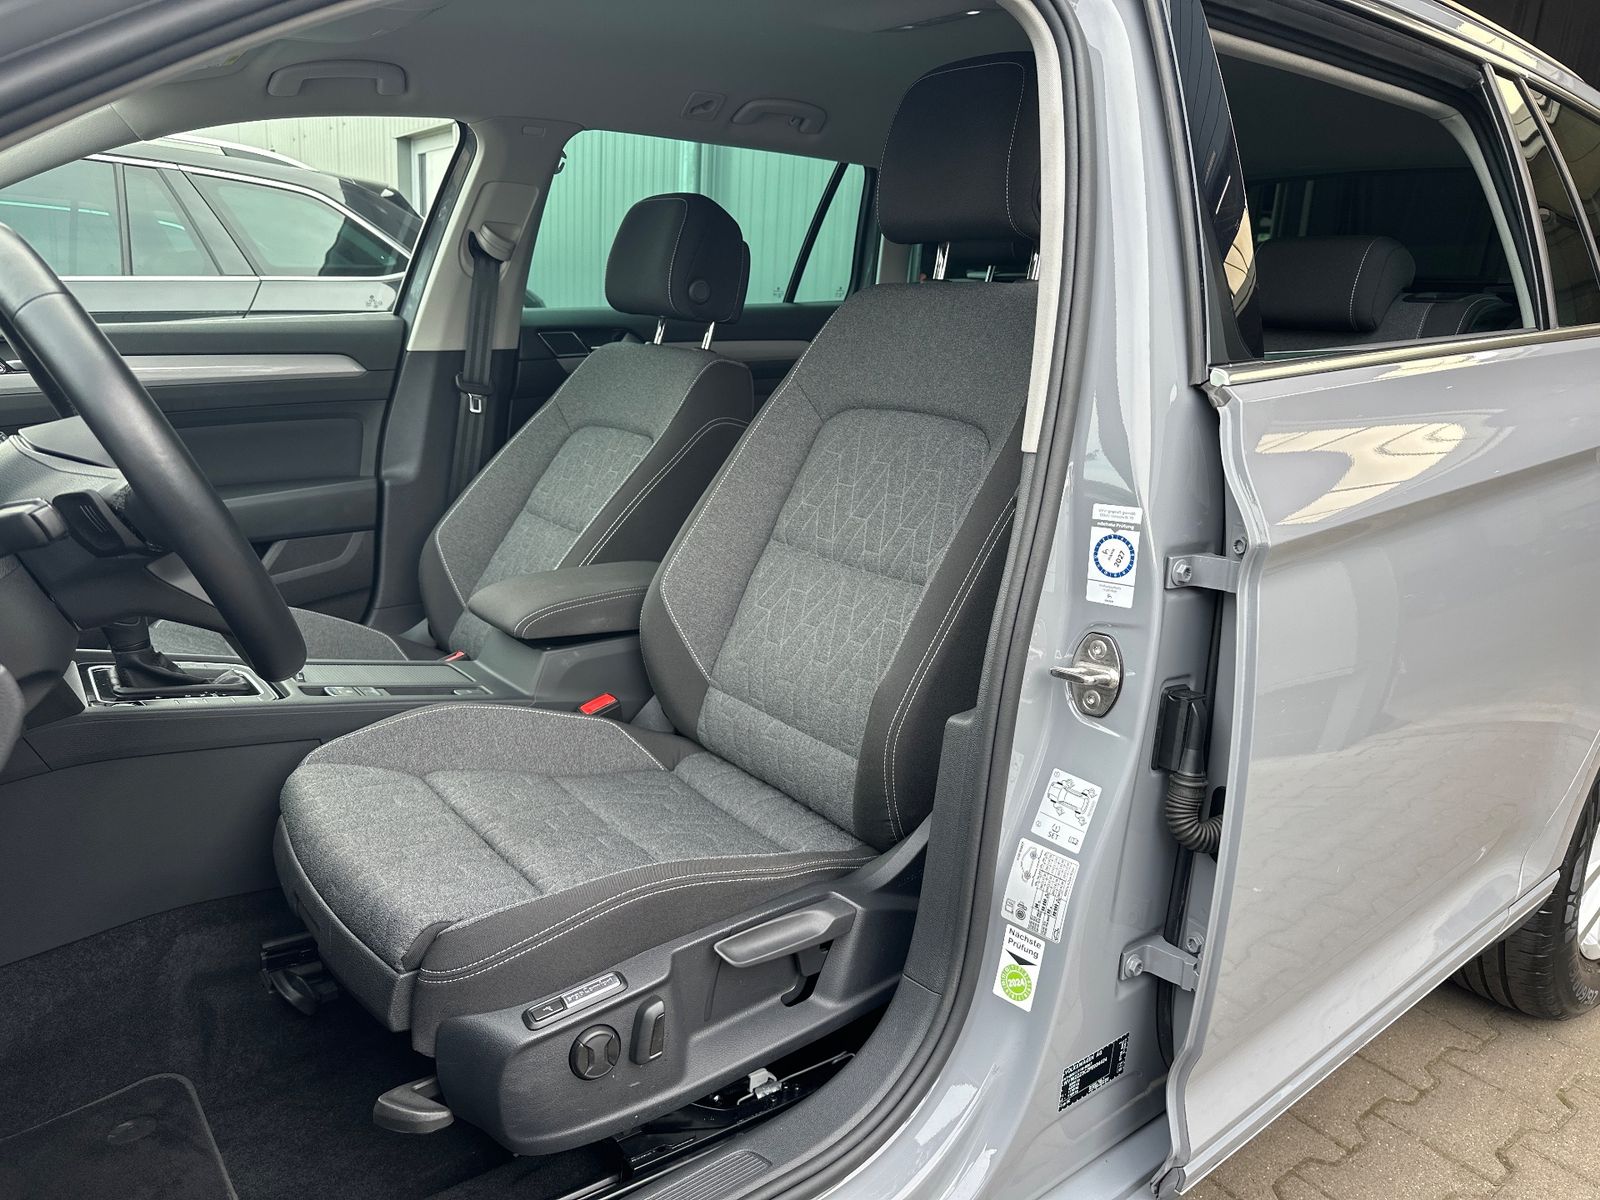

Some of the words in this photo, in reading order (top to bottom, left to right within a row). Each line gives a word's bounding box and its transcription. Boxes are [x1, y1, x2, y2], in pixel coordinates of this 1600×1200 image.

[1113, 550, 1125, 568] 2027
[1048, 831, 1059, 840] SET
[1008, 927, 1042, 949] Nächste
[1007, 937, 1040, 960] Prüfung
